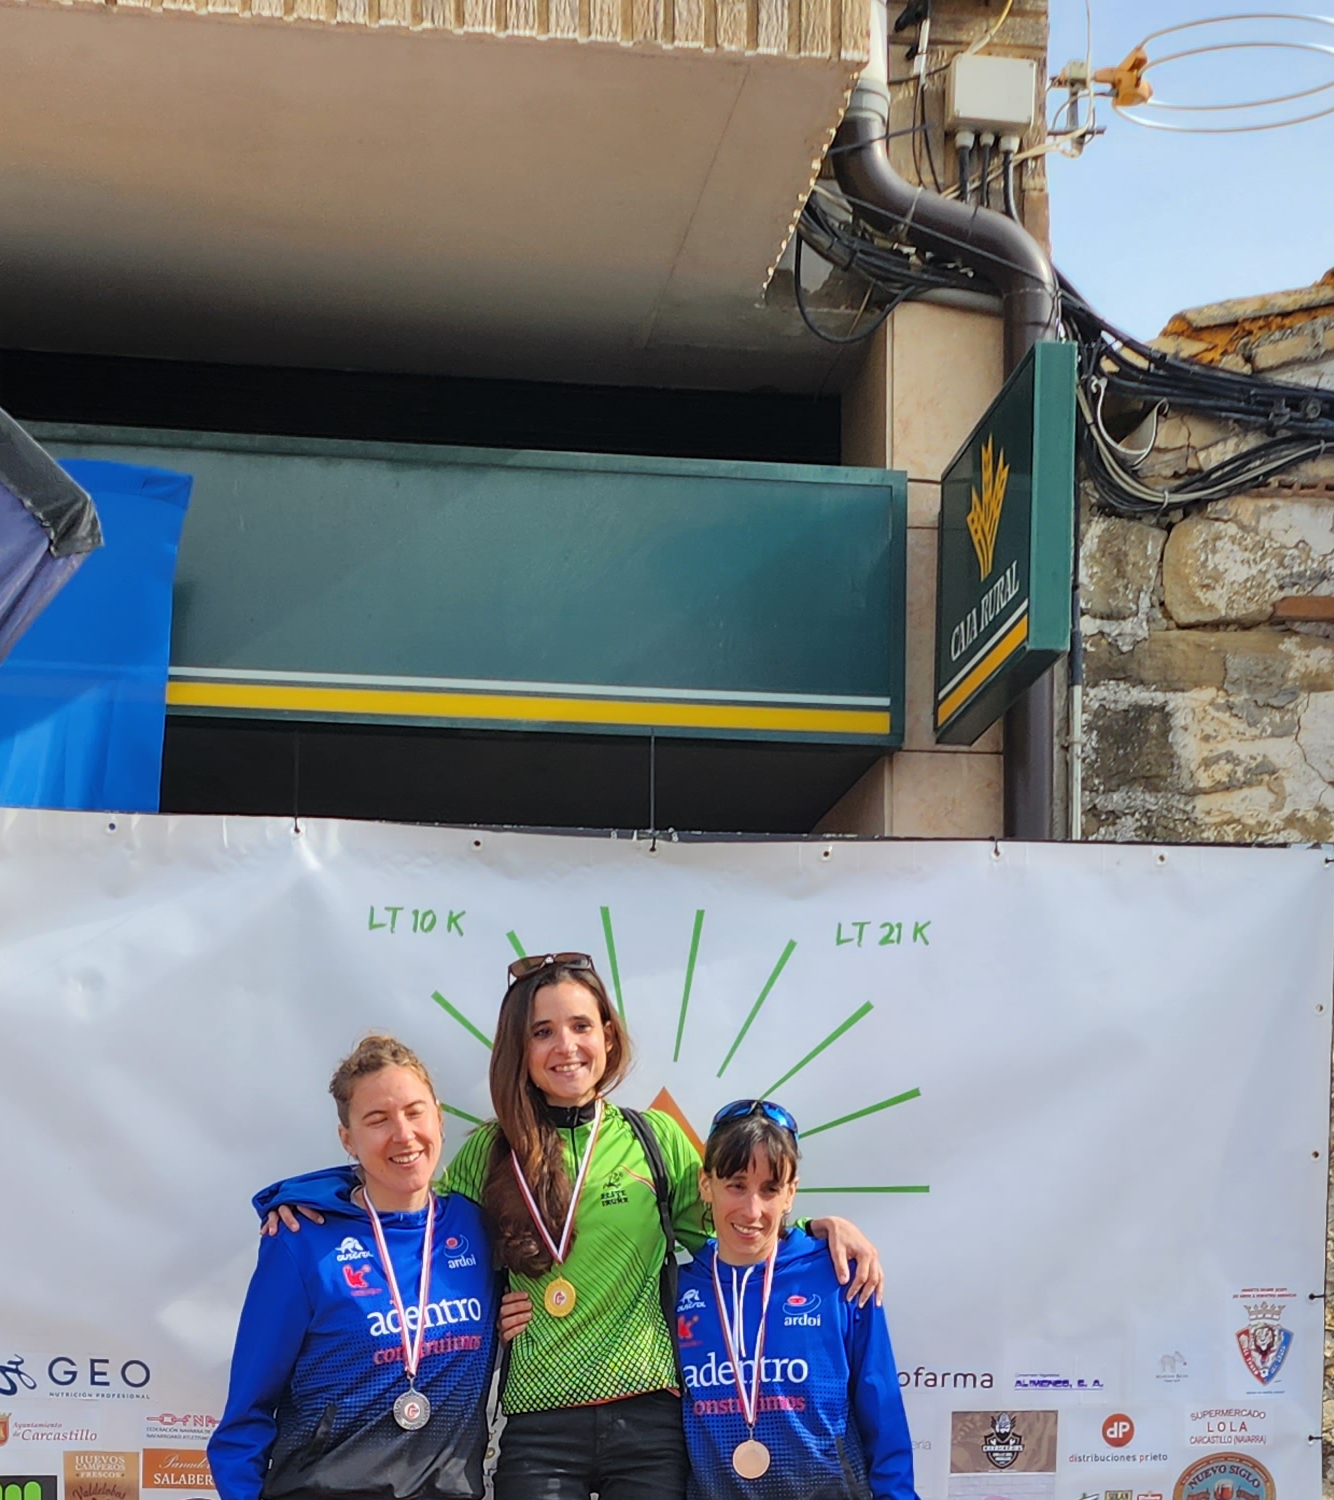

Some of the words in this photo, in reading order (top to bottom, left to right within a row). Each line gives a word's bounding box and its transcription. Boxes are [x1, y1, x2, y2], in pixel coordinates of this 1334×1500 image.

[949, 609, 979, 662] CAJA
[979, 560, 1020, 628] RURAL
[369, 905, 404, 934] LT
[412, 909, 437, 933] 10
[447, 909, 466, 937] K
[836, 922, 871, 947] LT
[878, 922, 902, 946] 21
[913, 920, 931, 946] K
[448, 1256, 477, 1269] ardoi
[784, 1313, 821, 1327] ardoi
[47, 1356, 151, 1388] GEO
[682, 1352, 809, 1388] adentro
[49, 1391, 93, 1399] NUTRICIÓN
[1190, 1409, 1266, 1421] SUPERMERCADO
[13, 1421, 63, 1430] Ayuntamiento
[1207, 1421, 1248, 1432] LOLA
[21, 1429, 98, 1442] Carcastillo
[1189, 1435, 1233, 1445] CARCASTILLO
[1233, 1435, 1267, 1445] (NAVARRA)
[75, 1455, 125, 1464] HUEVOS
[1068, 1453, 1137, 1463] distribuciones
[1139, 1453, 1168, 1463] prieto
[75, 1463, 126, 1471] CAMPEROS
[80, 1471, 122, 1479] FRESCOS
[153, 1472, 214, 1486] SALABER
[1187, 1464, 1227, 1489] NUEVO
[1228, 1464, 1261, 1489] SIGLO
